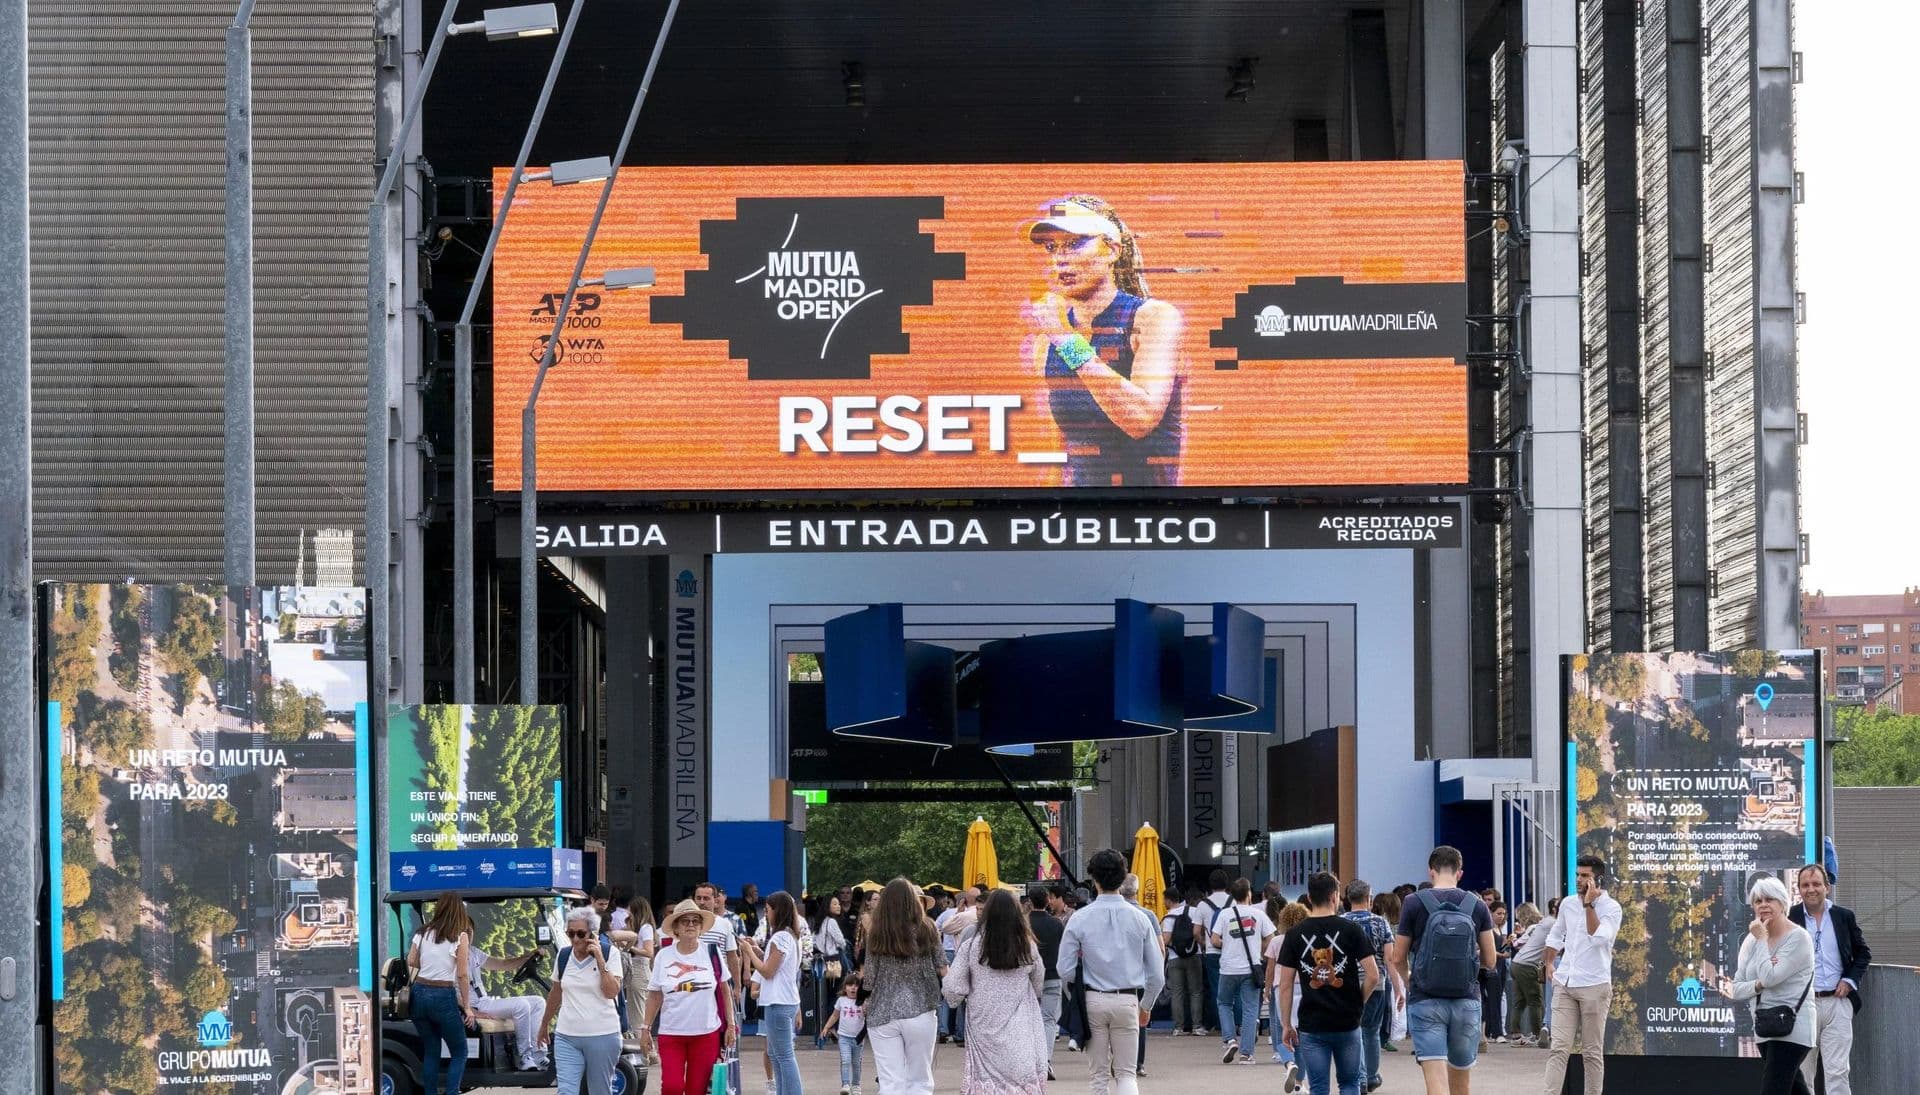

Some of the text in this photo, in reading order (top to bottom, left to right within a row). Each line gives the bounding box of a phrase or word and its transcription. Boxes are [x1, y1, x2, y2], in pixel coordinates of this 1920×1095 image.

[767, 251, 860, 277] MUTUA
[764, 278, 866, 299] MADRID
[777, 299, 851, 320] OPEN
[567, 316, 601, 328] 1000
[1293, 310, 1438, 332] MUTUAMADRILEÑA
[567, 338, 605, 349] WTA
[567, 353, 602, 364] 1000
[1318, 515, 1454, 529] ACREDITADOS
[535, 523, 668, 548] SALIDA
[769, 512, 1217, 547] ENTRADA PÚBLICO
[1337, 529, 1437, 541] RECOGIDA
[675, 607, 699, 842] MUTUAMADRILEÑA
[129, 748, 288, 767] UN RETO MUTUA
[1626, 777, 1750, 791] UN RETO MUTUA
[129, 783, 229, 801] PARA 2023
[410, 791, 436, 801] ESTE
[468, 791, 497, 801] TIENE
[410, 810, 480, 822] UN ÚNICO FIN:
[1626, 803, 1703, 816] PARA 2023
[410, 832, 519, 843] SEGUIR AUMENTANDO
[1627, 831, 1762, 842] Por segundo año consecutivo,
[1627, 841, 1656, 852] Grupo
[1658, 841, 1686, 850] Mutua
[1701, 842, 1758, 853] compromete
[1635, 852, 1668, 860] realizar
[1689, 852, 1735, 862] plantación
[1736, 852, 1749, 860] de
[1627, 862, 1661, 871] cientos
[1662, 862, 1674, 871] de
[1675, 862, 1709, 871] árboles
[1724, 862, 1757, 871] Madrid
[1646, 1007, 1736, 1023] GRUPOMUTUA
[1687, 1026, 1735, 1034] SOSTENIBILIDAD
[158, 1048, 272, 1070] GRUPOMUTUA
[170, 1076, 191, 1084] VIAJE
[192, 1075, 199, 1083] A
[200, 1075, 209, 1083] LA
[210, 1073, 272, 1083] SOSTENIBILIDAD
